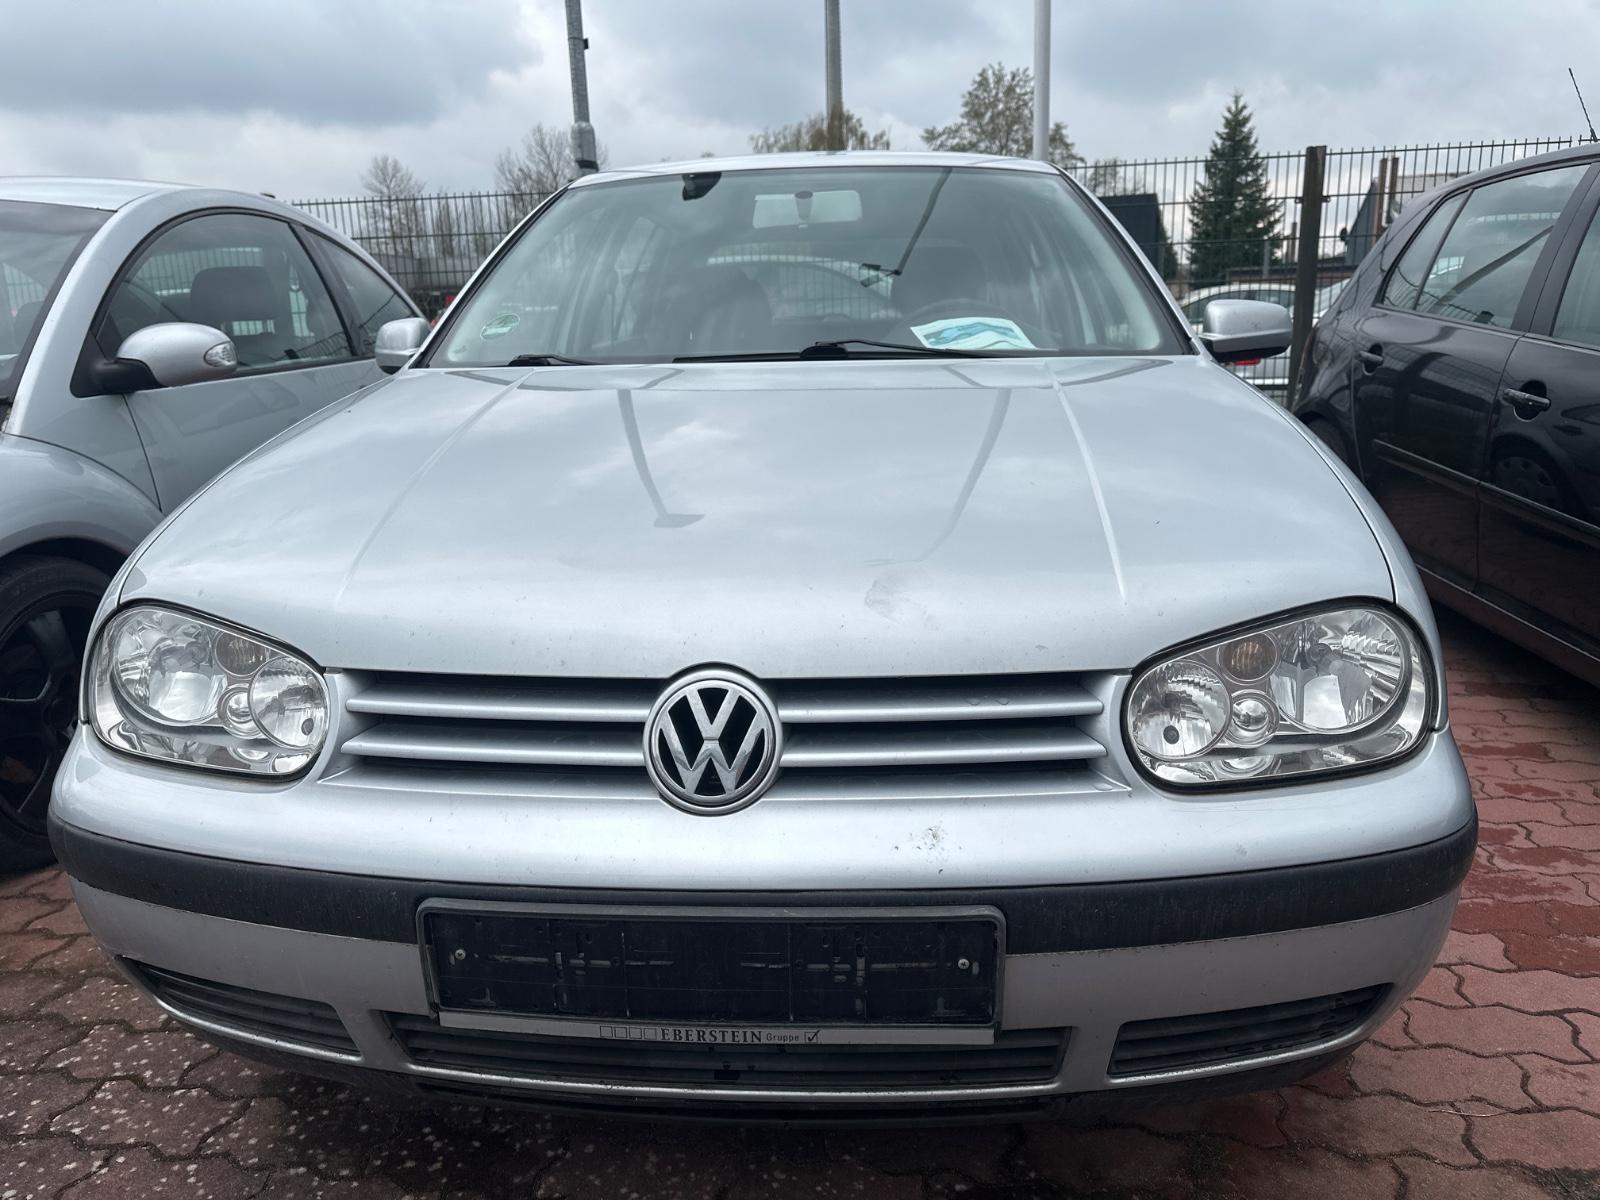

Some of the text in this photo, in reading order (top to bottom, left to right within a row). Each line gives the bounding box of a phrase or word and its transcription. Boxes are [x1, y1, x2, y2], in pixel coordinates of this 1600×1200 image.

[651, 681, 771, 803] VW
[661, 1028, 800, 1043] EBERSTEIN Gruppe
